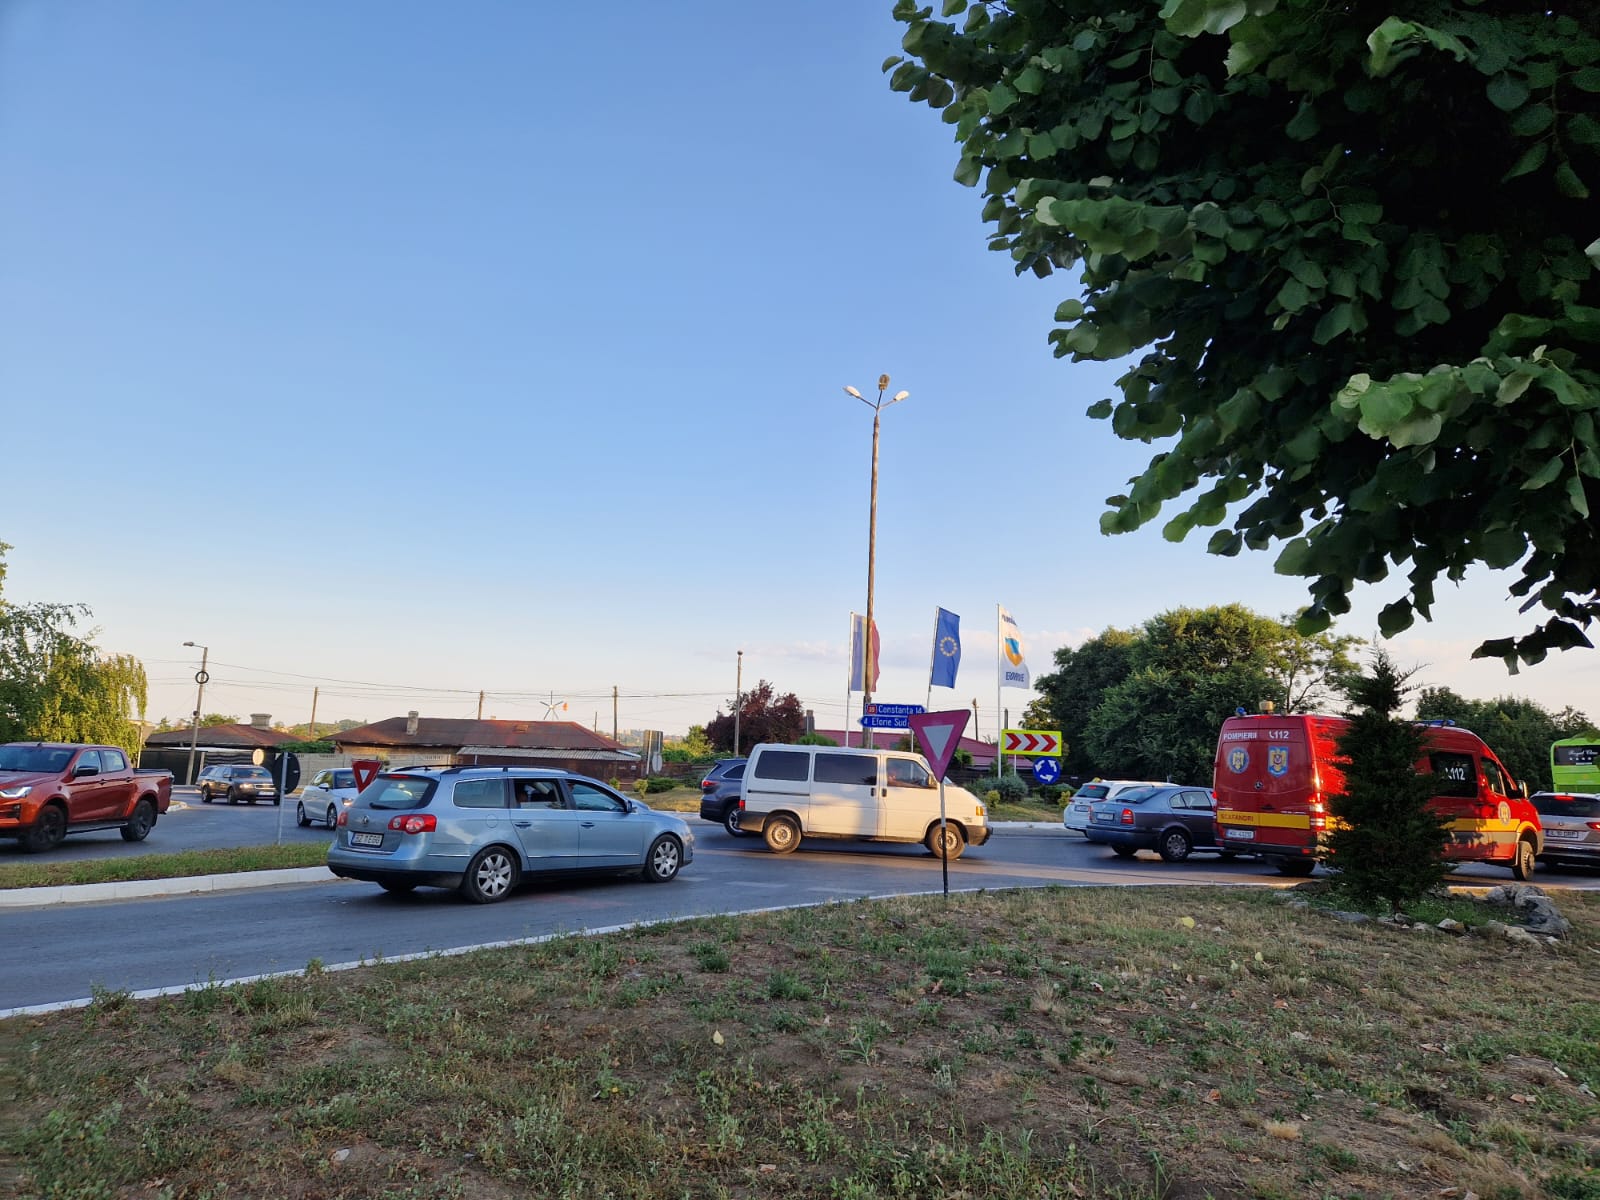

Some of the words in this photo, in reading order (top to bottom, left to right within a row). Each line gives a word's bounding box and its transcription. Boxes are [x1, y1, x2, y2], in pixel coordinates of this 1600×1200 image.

[863, 717, 868, 725] 4
[871, 717, 892, 726] Eforie
[894, 718, 907, 727] Sud
[1275, 730, 1289, 739] 112
[1450, 767, 1466, 780] 112
